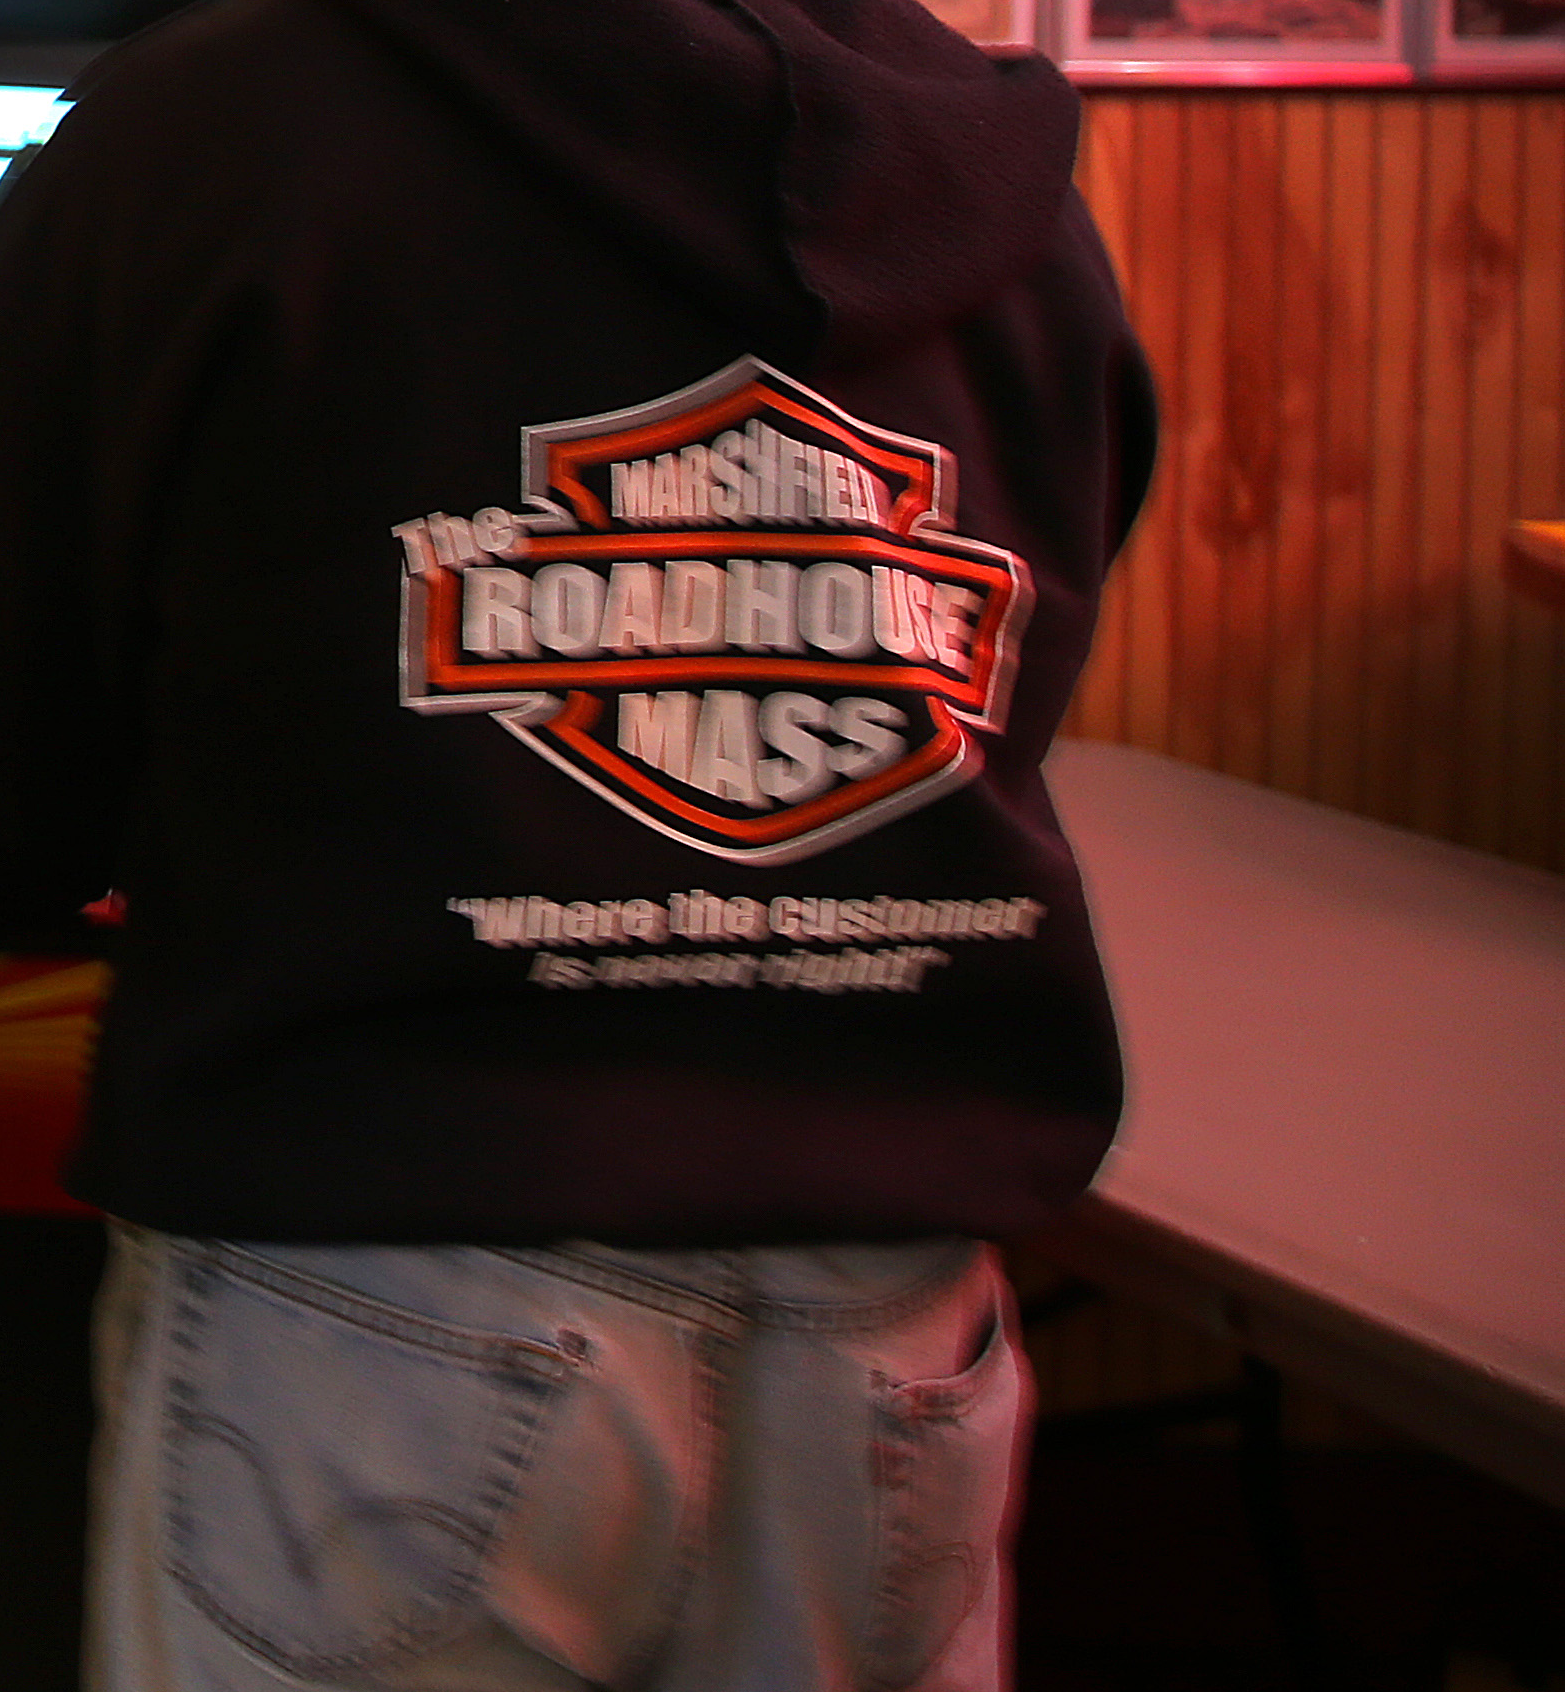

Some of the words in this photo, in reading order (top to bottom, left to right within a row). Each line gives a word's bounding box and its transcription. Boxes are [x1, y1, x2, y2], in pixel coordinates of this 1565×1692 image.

[391, 506, 519, 577] The
[461, 559, 976, 670] ROADHOUSE
[617, 690, 907, 806] MASS
[667, 888, 769, 943] the
[768, 895, 1045, 942] customer
